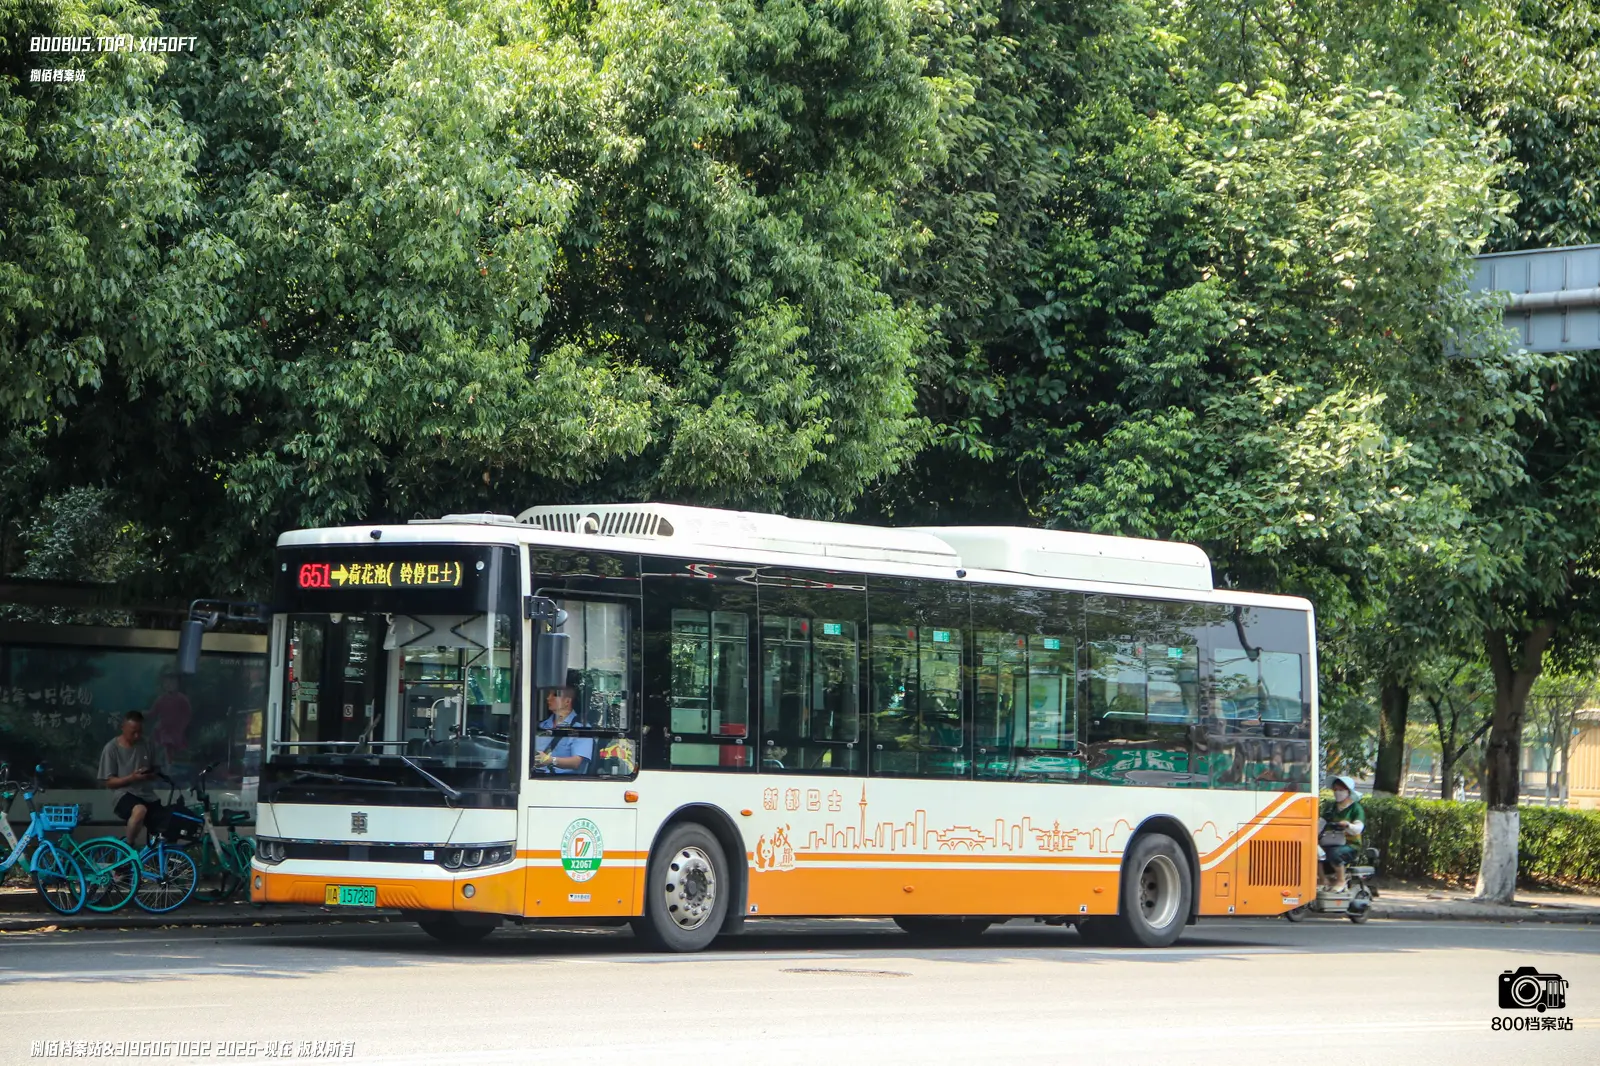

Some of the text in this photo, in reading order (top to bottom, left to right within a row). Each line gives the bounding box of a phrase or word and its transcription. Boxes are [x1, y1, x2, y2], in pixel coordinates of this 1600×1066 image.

[299, 563, 332, 588] 651
[763, 787, 842, 812] 新都巴士
